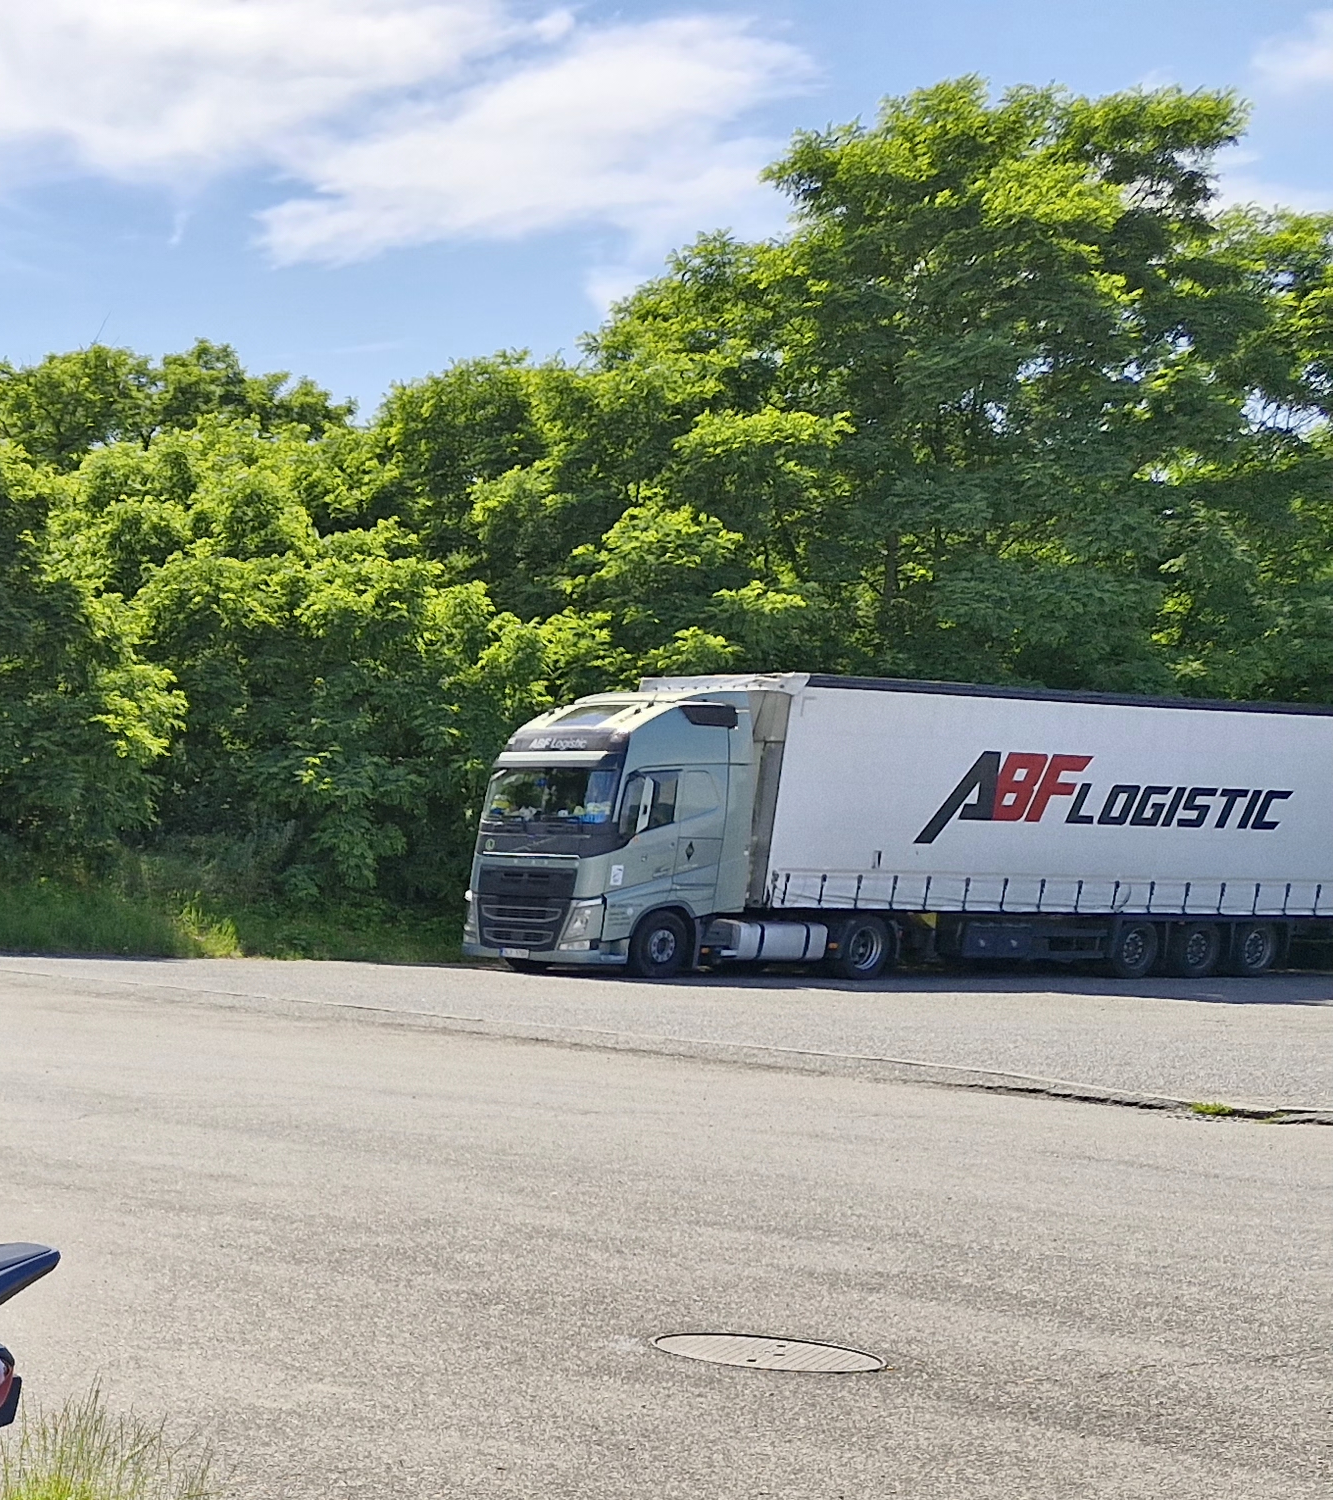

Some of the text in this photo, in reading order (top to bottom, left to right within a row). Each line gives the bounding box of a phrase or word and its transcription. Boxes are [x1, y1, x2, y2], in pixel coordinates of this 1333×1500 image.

[550, 738, 587, 750] Logistic
[913, 751, 1294, 844] ABF LOGISTIC
